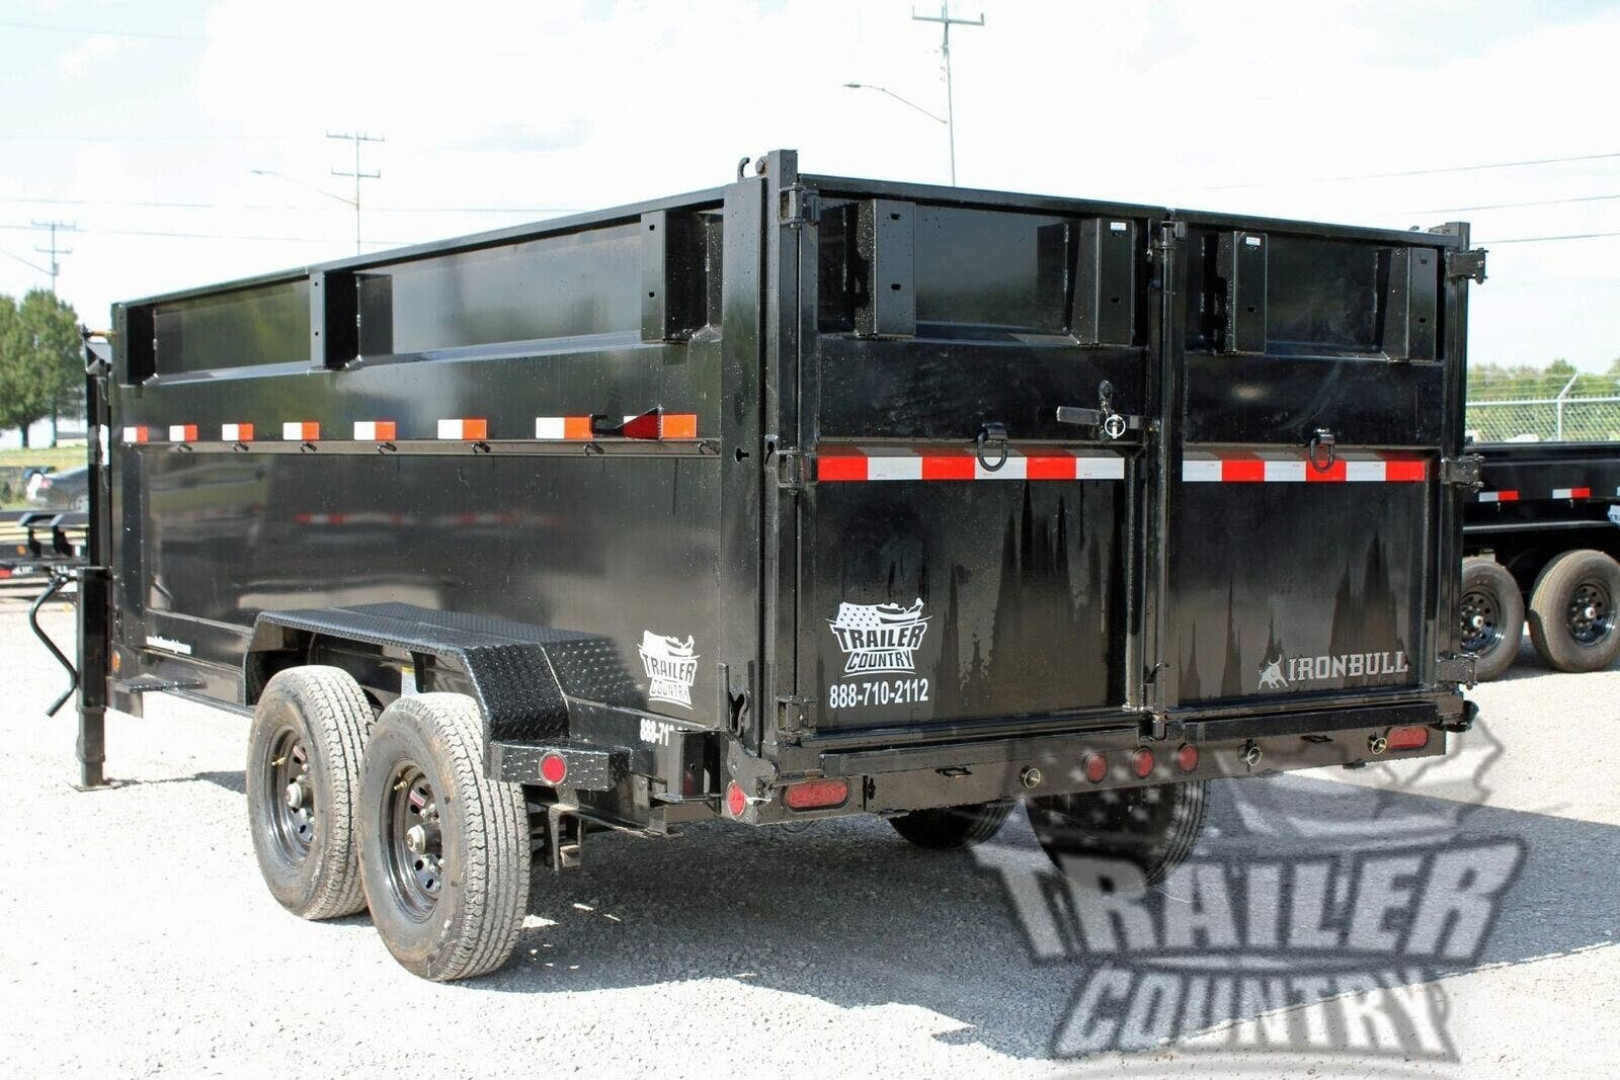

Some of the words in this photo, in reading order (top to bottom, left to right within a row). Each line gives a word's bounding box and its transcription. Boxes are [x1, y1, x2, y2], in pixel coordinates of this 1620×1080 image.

[832, 624, 924, 651] TRAILER
[642, 653, 697, 685] TRAILER
[846, 651, 914, 671] COUNTRY
[1288, 651, 1409, 682] IRONBULL
[829, 678, 929, 709] 888-710-2112
